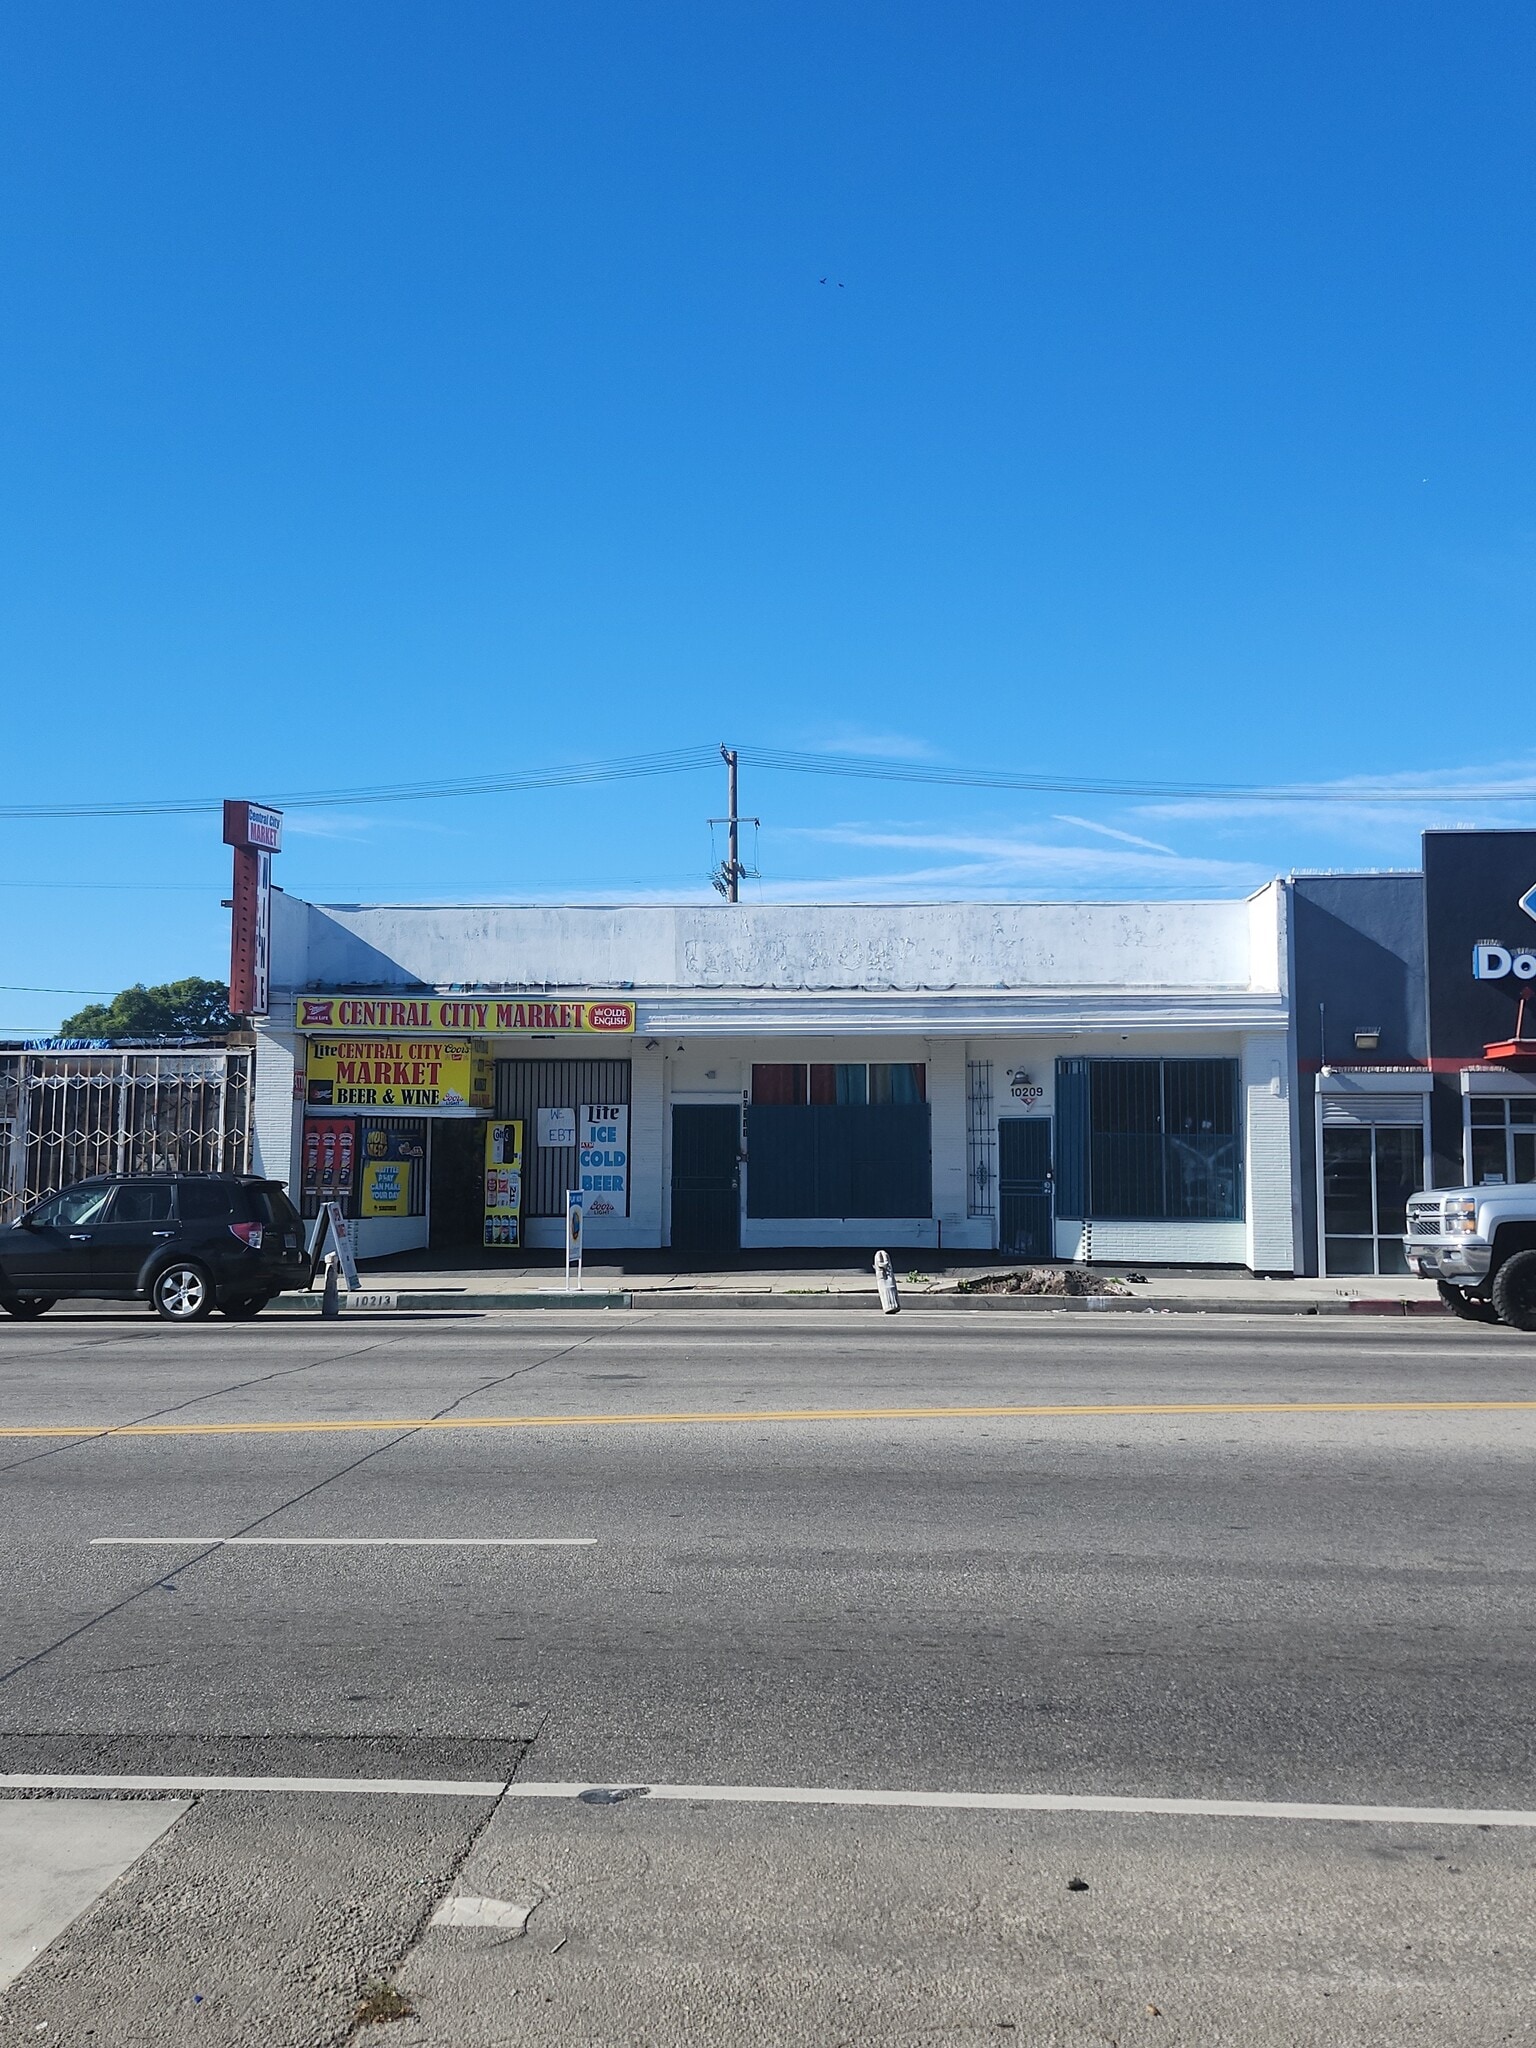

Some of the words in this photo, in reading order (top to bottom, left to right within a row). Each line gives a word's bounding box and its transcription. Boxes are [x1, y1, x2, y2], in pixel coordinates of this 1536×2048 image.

[249, 809, 269, 824] Central
[270, 815, 280, 829] City
[251, 822, 277, 847] MARKET
[338, 1001, 432, 1026] CENTRAL
[439, 1002, 489, 1027] CITY
[496, 1003, 585, 1028] MARKET
[603, 1008, 626, 1017] OLDE
[594, 1016, 628, 1025] ENGLISH
[314, 1044, 338, 1059] Lite
[338, 1043, 403, 1059] CENTRAL
[408, 1044, 442, 1059] CITY
[336, 1061, 442, 1085] MARKET
[337, 1088, 377, 1104] BEER
[382, 1088, 395, 1104] &
[401, 1089, 440, 1105] WINE
[1011, 1087, 1043, 1097] 10209
[551, 1109, 564, 1119] WE
[587, 1106, 619, 1123] Lite
[549, 1129, 574, 1141] EBT
[591, 1126, 616, 1142] ICE
[581, 1150, 625, 1167] COLD
[371, 1183, 384, 1191] CAN
[384, 1182, 400, 1191] MAKE
[582, 1176, 624, 1191] BEER
[372, 1191, 388, 1199] YOUR
[388, 1191, 399, 1199] DAY
[590, 1201, 614, 1210] Coors
[355, 1295, 391, 1307] 10213
